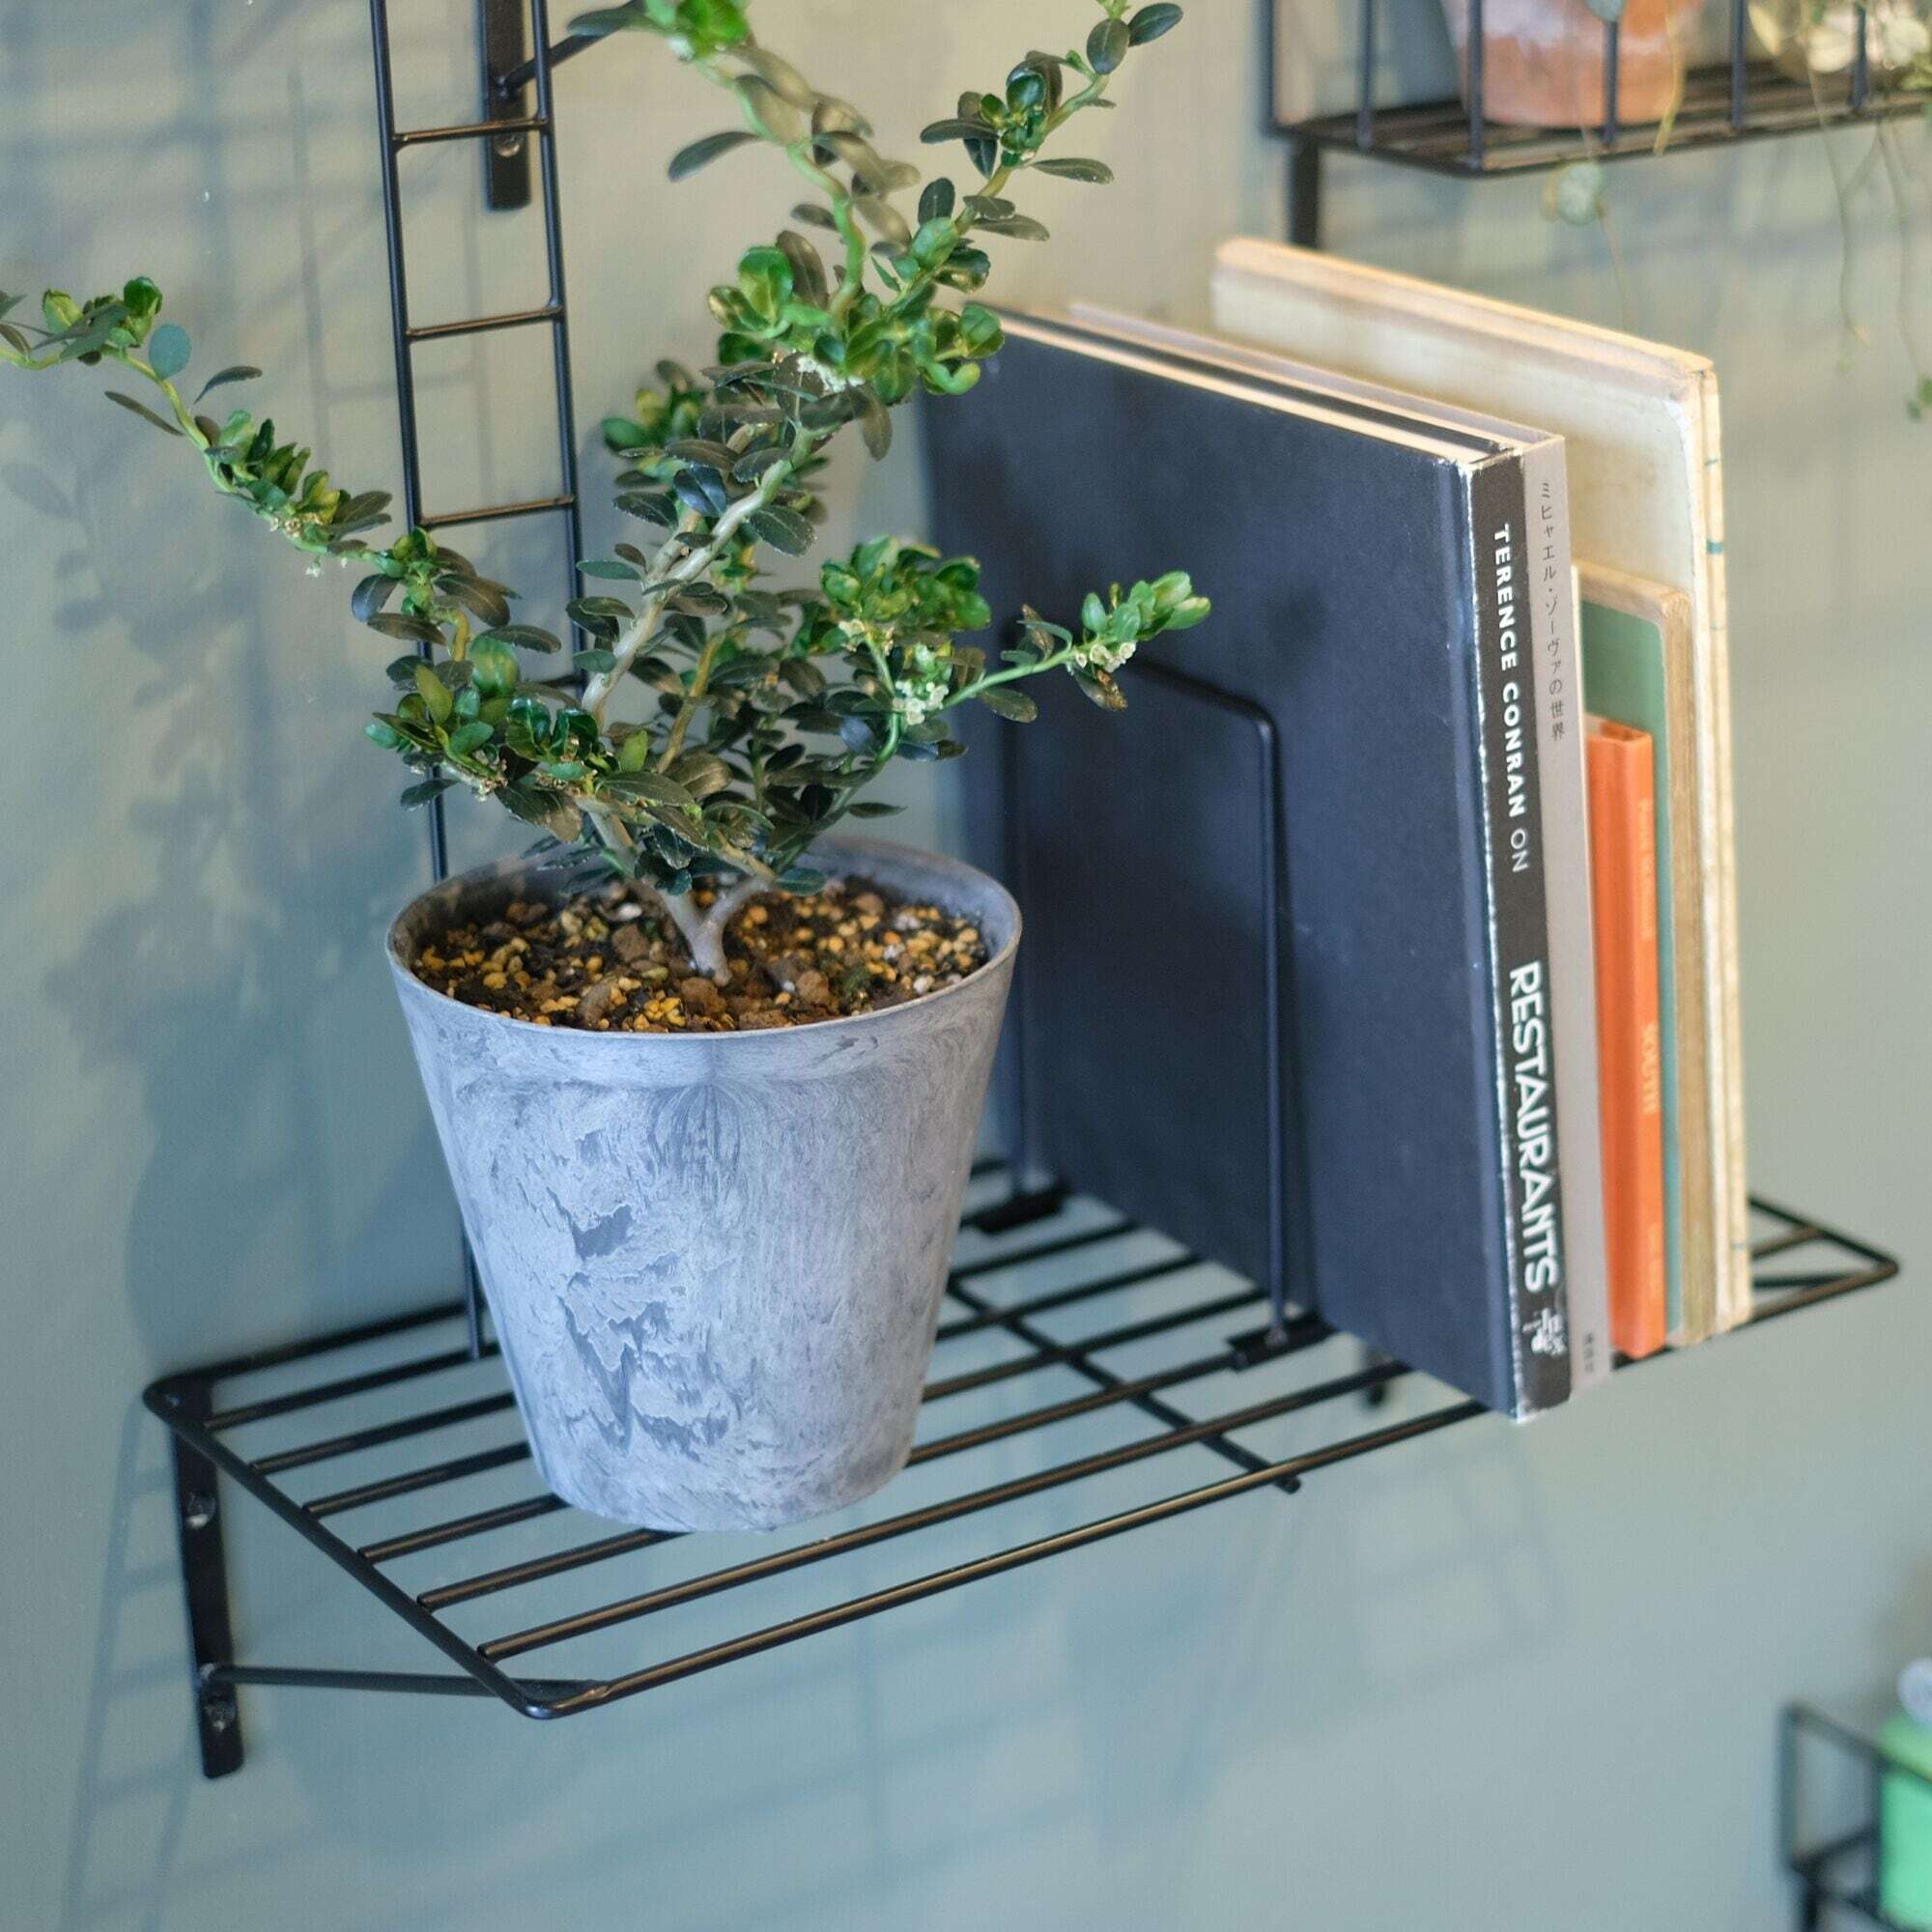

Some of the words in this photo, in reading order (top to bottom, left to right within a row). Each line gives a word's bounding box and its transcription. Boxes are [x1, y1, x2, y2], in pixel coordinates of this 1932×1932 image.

[1493, 523, 1519, 671] TERENCE
[1541, 482, 1565, 743] ミヒャエル・ゾーヴァの世界
[1502, 682, 1526, 817] CONRAN
[1510, 828, 1528, 873] ON
[1509, 961, 1559, 1293] RESTAURANTS
